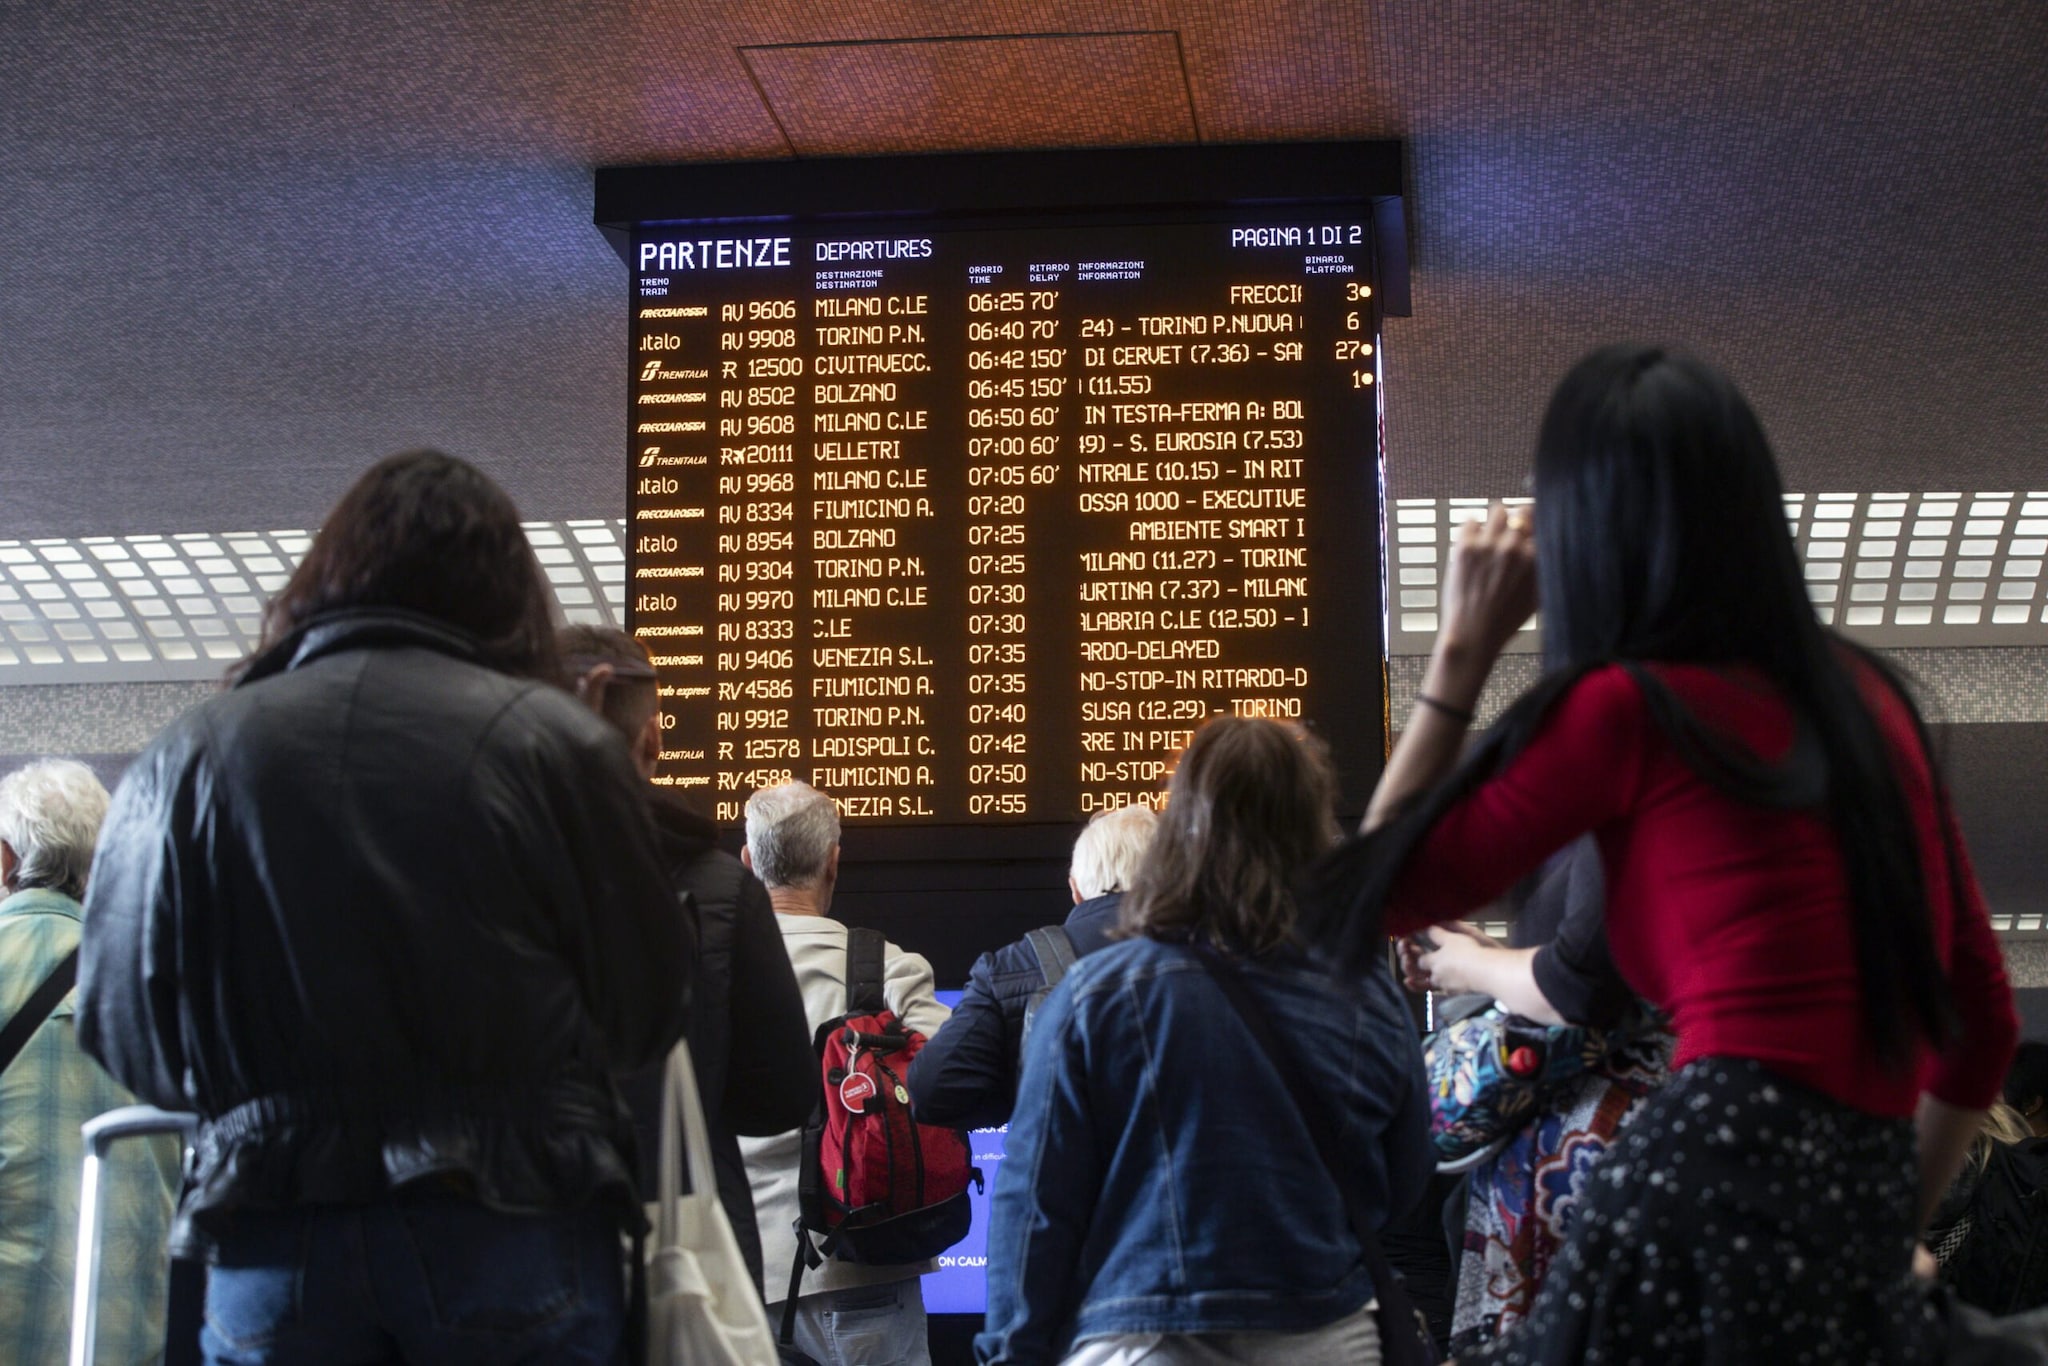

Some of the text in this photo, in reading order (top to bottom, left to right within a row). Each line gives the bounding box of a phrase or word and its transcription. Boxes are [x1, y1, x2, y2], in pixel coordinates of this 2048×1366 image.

[1232, 226, 1362, 247] PAGINA 1 DI 2
[641, 238, 791, 270] PARTENZE
[816, 239, 932, 261] DEPARTURES
[1305, 255, 1345, 264] BINARIO
[815, 269, 883, 280] DESTINAZIONE
[968, 265, 1003, 274] ORARIO
[1029, 263, 1070, 272] RITARDO
[1078, 261, 1145, 271] INFORMAZIONI
[1305, 264, 1354, 274] PLATFORM
[640, 277, 670, 286] TRENO
[815, 279, 878, 290] DESTINATION
[969, 275, 991, 284] TIME
[1029, 273, 1060, 282] DELAY
[1078, 271, 1141, 281] INFORMATION
[640, 287, 668, 297] TRAIN
[1347, 283, 1359, 300] 3
[722, 301, 795, 321] AV 9606
[815, 296, 927, 317] MILANO C.LE
[968, 293, 1023, 312] 06:25
[639, 308, 707, 318] FRECCIAROSSA
[1348, 312, 1359, 329] 6
[968, 322, 1023, 340] 06:40
[1138, 314, 1292, 335] TORINO P.NUOVA
[721, 329, 795, 350] AV 9908
[815, 325, 924, 345] TORINO P.N.
[1085, 344, 1249, 366] DI CERVET (7.36)
[1335, 341, 1360, 359] 27
[748, 358, 802, 377] 12500
[815, 354, 930, 374] CIVITAVECC.
[968, 351, 1024, 369] 06:42
[657, 369, 708, 380] TRENITALIA
[1353, 372, 1361, 388] 1
[814, 383, 896, 403] BOLZANO
[968, 379, 1024, 398] 06:45
[1089, 376, 1151, 395] (11.55)
[638, 393, 706, 404] FRECCIAROSSA
[720, 387, 794, 407] AV 8502
[814, 411, 927, 432] MILANO C.LE
[968, 408, 1024, 427] 06:50
[1085, 402, 1265, 424] IN TESTA-FERMA A:
[637, 422, 705, 432] FRECCIAROSSA
[720, 415, 794, 436] AV 9608
[968, 437, 1024, 456] 07:00
[1129, 430, 1302, 451] S. EUROSIA (7.53)
[814, 441, 899, 460] VELLETRI
[655, 456, 706, 466] TRENITALIA
[1079, 459, 1303, 482] NTRALE (10.15) IN RIT
[719, 473, 793, 494] AV 9968
[813, 469, 926, 490] MILANO C.LE
[968, 466, 1024, 485] 07:05
[813, 498, 933, 519] FIUMICINO A.
[968, 496, 1024, 515] 07:20
[1079, 489, 1305, 512] OSSA 1000 EXECUTIVE
[636, 509, 704, 519] FRECCIAROSSA
[719, 503, 793, 523] AV 8334
[813, 529, 895, 549] BOLZANO
[968, 525, 1024, 544] 07:25
[1129, 519, 1289, 540] AMBIENTE SMART
[719, 532, 793, 552] AV 8954
[813, 558, 924, 578] TORINO P.N.
[968, 555, 1024, 574] 07:25
[1152, 550, 1215, 569] (11.27)
[635, 567, 704, 577] FRECCIAROSSA
[718, 562, 793, 582] AV 9304
[813, 587, 927, 608] MILANO C.LE
[969, 585, 1025, 604] 07:30
[1160, 580, 1219, 599] (7.37)
[718, 591, 793, 611] AV 9970
[969, 615, 1025, 633] 07:30
[1160, 609, 1276, 629] C.LE (12.50)
[635, 626, 703, 636] FRECCIAROSSA
[718, 620, 793, 641] AV 8333
[718, 650, 792, 670] AV 9406
[813, 647, 933, 667] VENEZIA S.L.
[969, 644, 1025, 663] 07:35
[813, 676, 933, 697] FIUMICINO A.
[969, 674, 1025, 693] 07:35
[1080, 668, 1307, 690] NO-STOP-IN RITARDO-D
[744, 680, 792, 698] 4586
[813, 707, 924, 726] TORINO P.N.
[969, 704, 1025, 723] 07:40
[1081, 698, 1300, 721] SUSA (12.29) TORINO
[717, 710, 788, 730] AV 9912
[744, 739, 800, 758] 12578
[812, 736, 934, 757] LADISPOLI C.
[969, 734, 1025, 753] 07:42
[1123, 732, 1143, 750] IN
[813, 766, 934, 787] FIUMICINO A.
[969, 764, 1025, 783] 07:50
[716, 802, 738, 820] AV
[898, 797, 933, 815] S.L.
[969, 795, 1025, 813] 07:55
